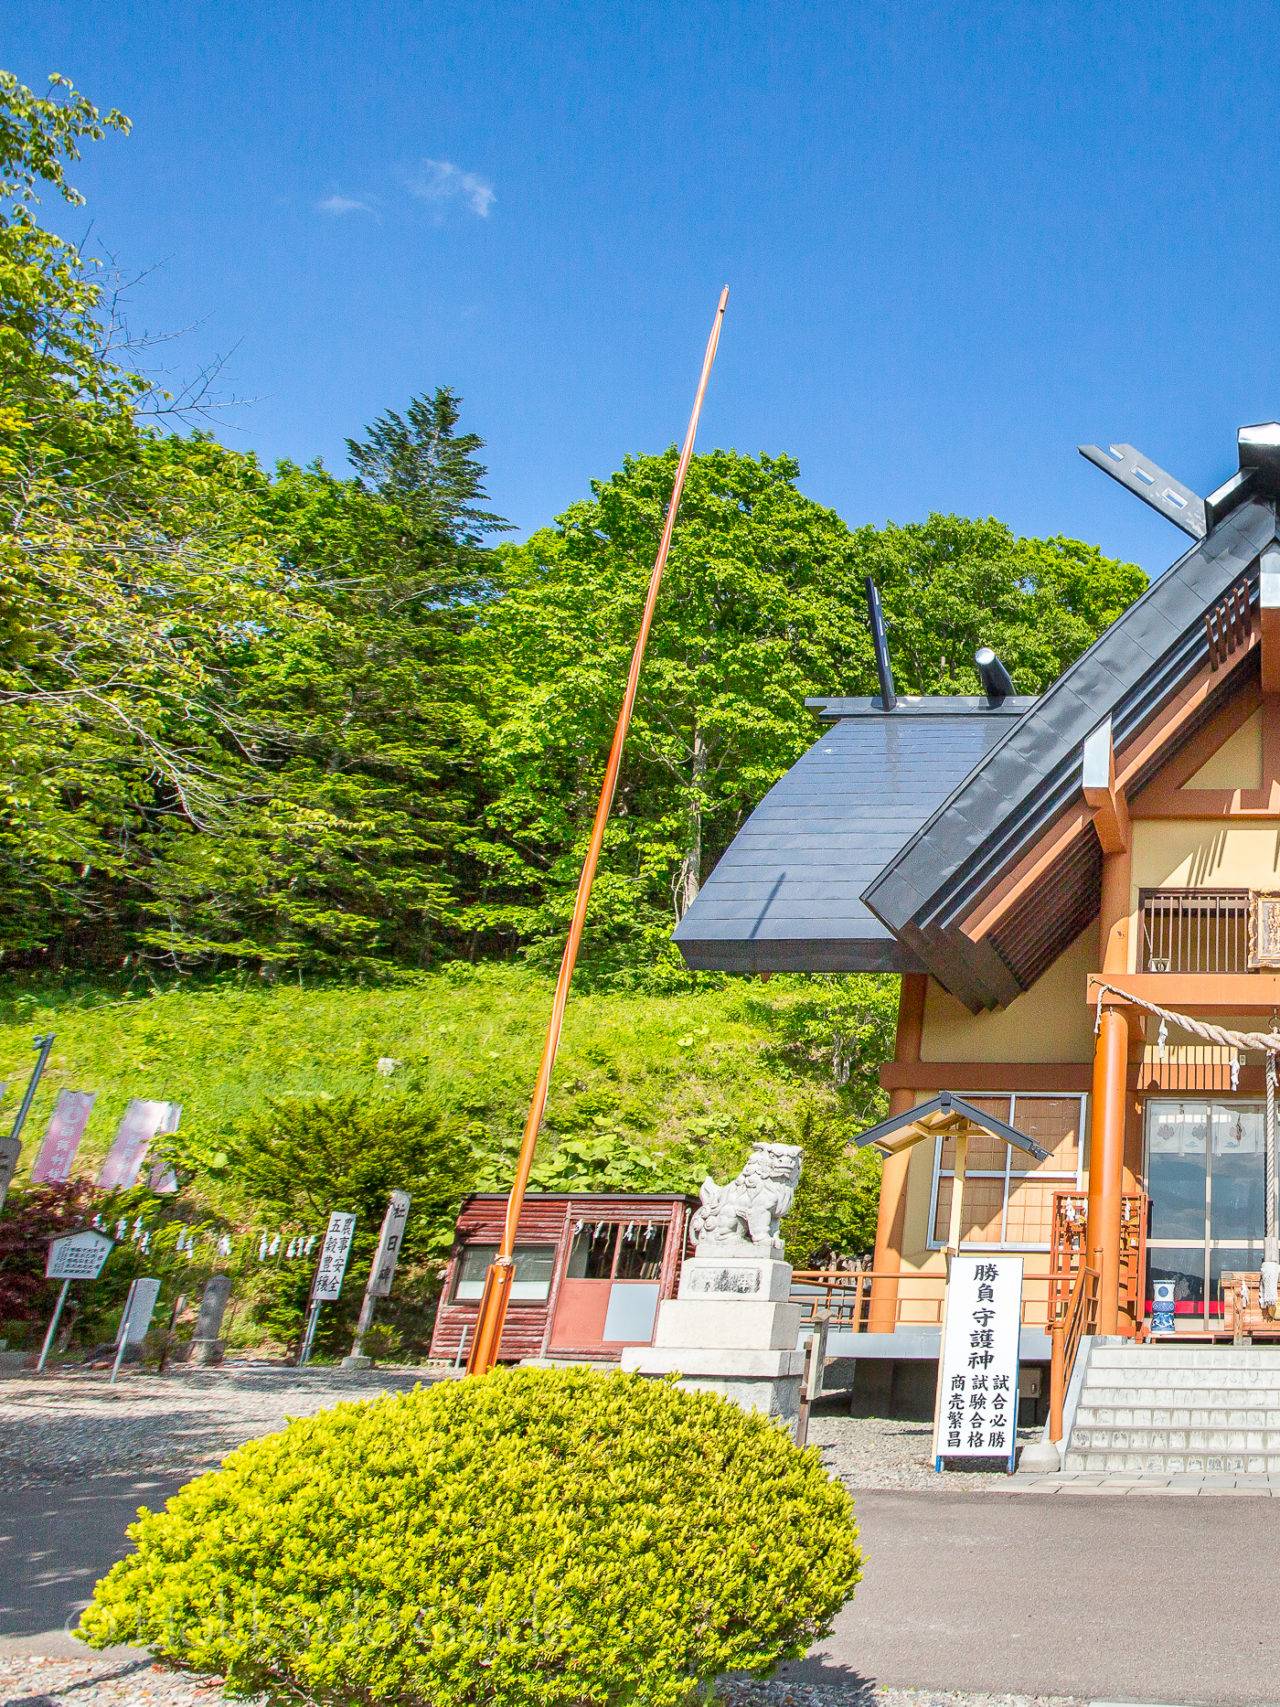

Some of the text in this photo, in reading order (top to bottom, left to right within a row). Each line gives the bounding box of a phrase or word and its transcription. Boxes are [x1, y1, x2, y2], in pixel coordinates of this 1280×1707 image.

[329, 1218, 353, 1292] 農事安全
[968, 1263, 999, 1370] 勝負守護神
[947, 1374, 966, 1448] 商売繁昌
[966, 1374, 988, 1448] 試験合格
[987, 1374, 1010, 1448] 試合必勝
